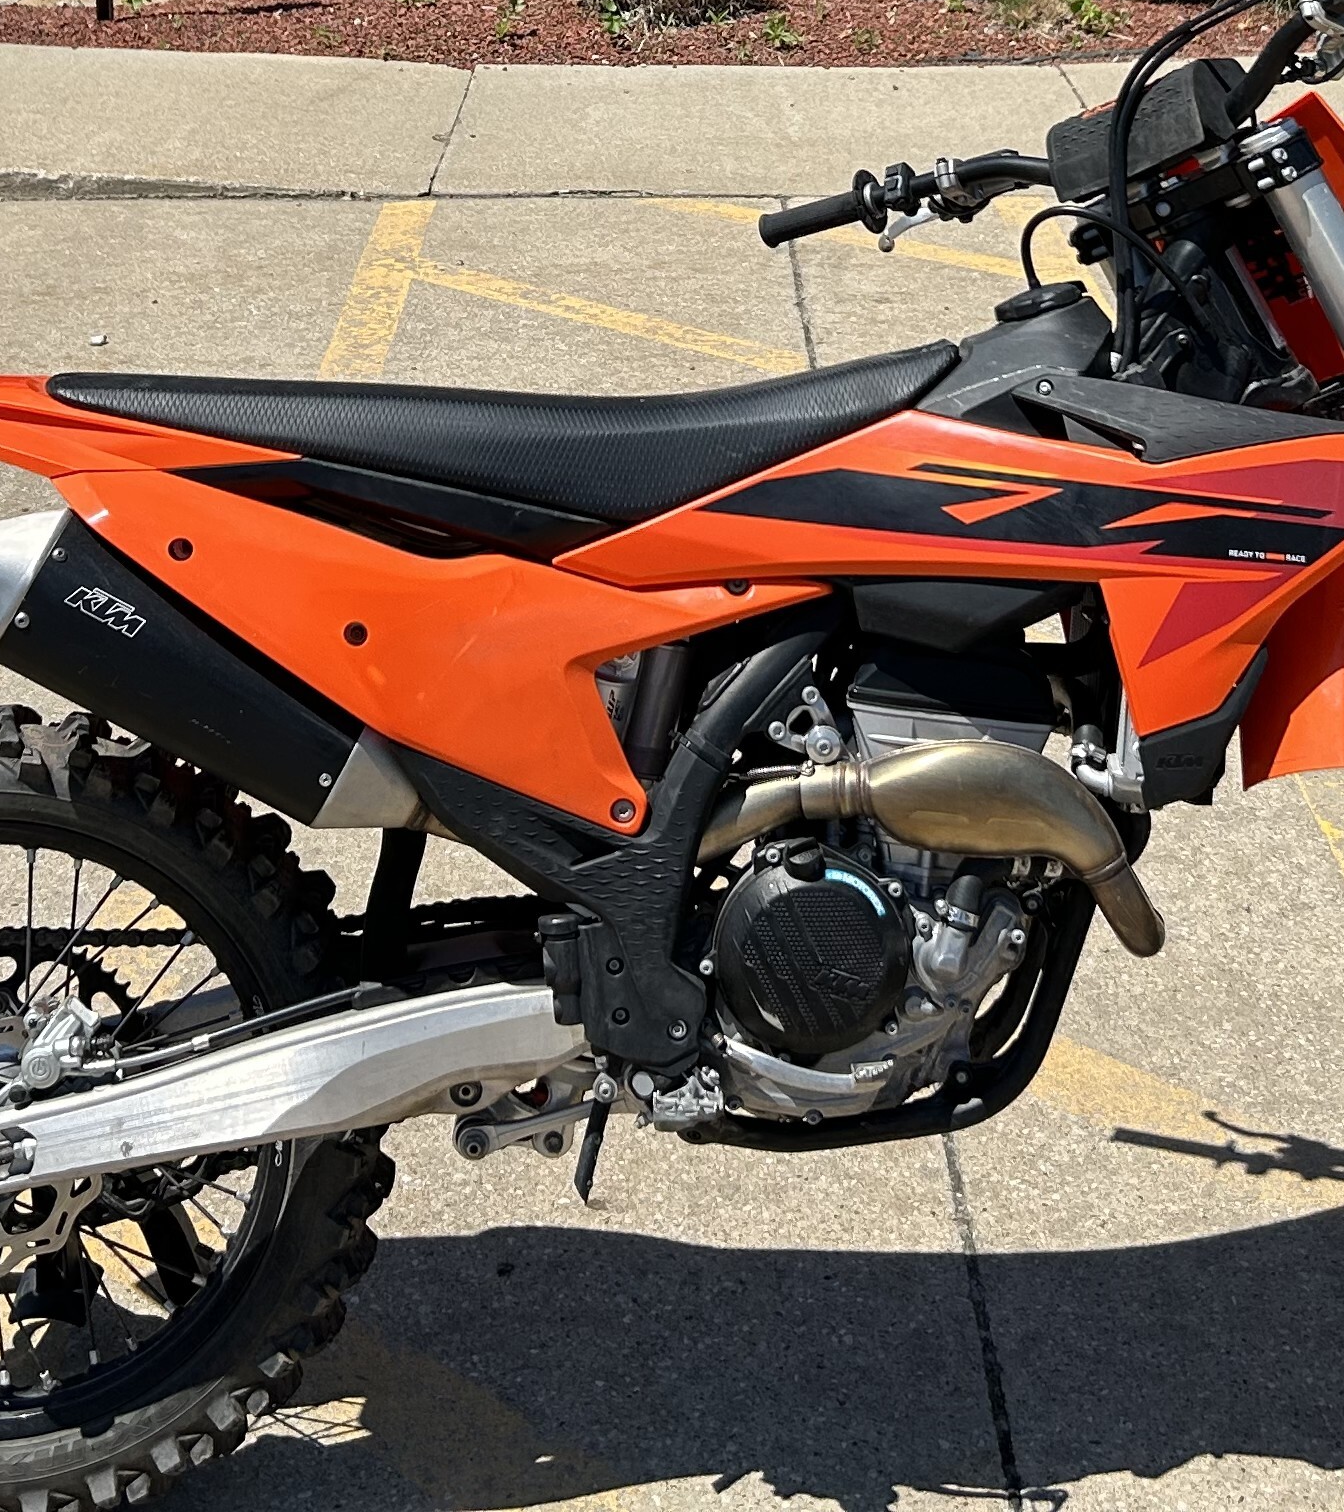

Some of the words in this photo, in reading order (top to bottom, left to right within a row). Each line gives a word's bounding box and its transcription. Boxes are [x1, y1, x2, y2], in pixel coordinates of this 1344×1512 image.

[1228, 549, 1254, 558] READY
[1255, 551, 1266, 560] TO
[1285, 554, 1307, 563] RACE
[63, 586, 147, 638] KTM
